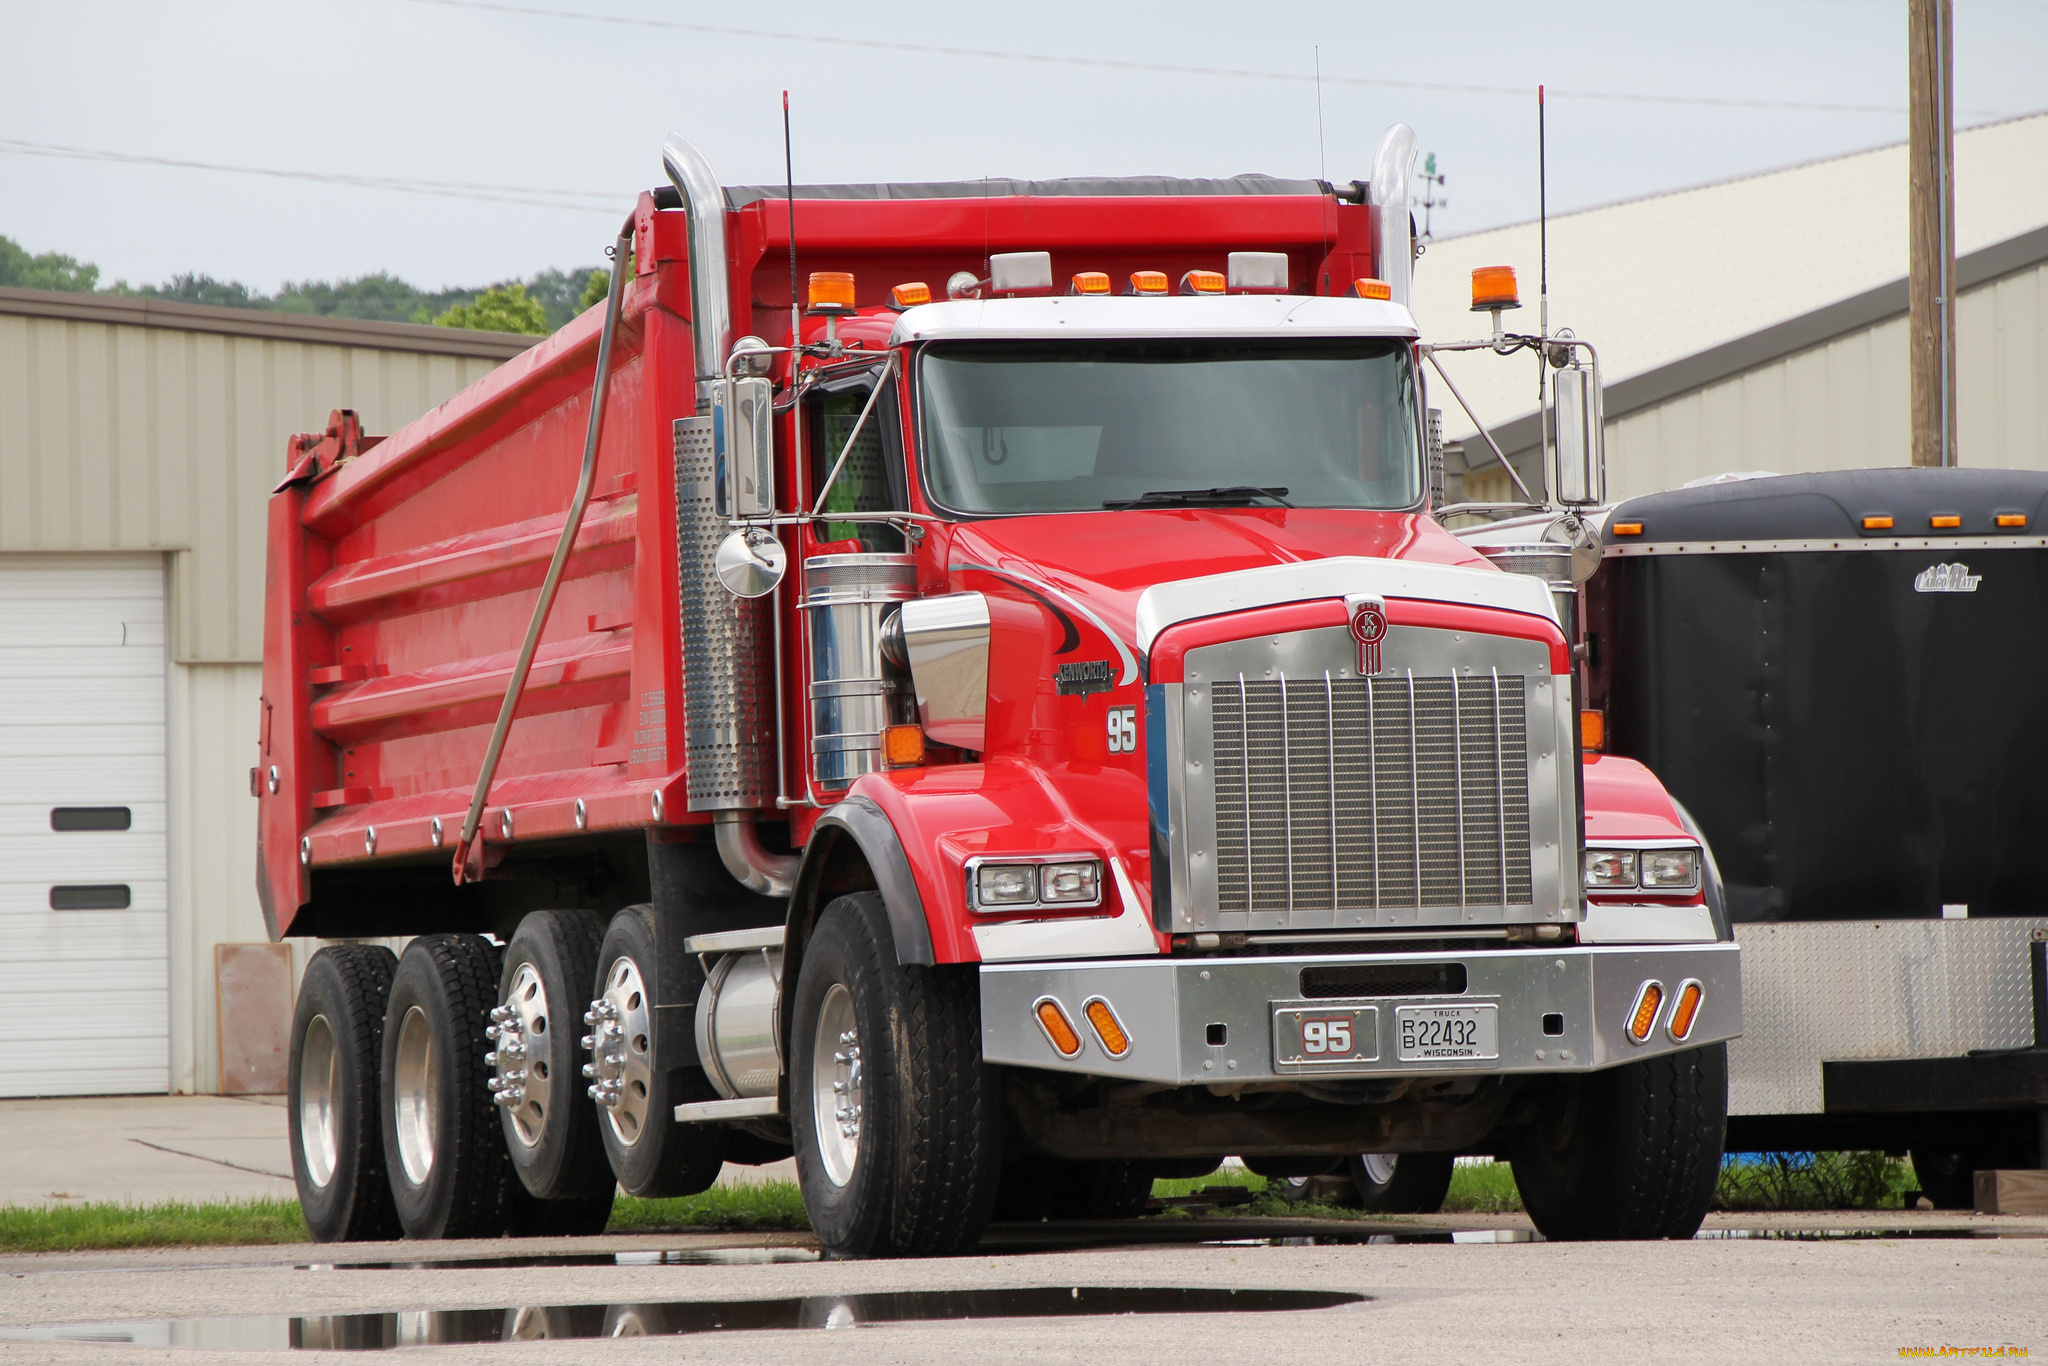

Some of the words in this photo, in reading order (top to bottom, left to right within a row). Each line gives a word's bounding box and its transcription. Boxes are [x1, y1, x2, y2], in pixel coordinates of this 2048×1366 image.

[1058, 660, 1109, 682] KENWORTH
[1107, 706, 1136, 754] 95
[1302, 1018, 1353, 1055] 95
[1418, 1020, 1477, 1046] 22432
[1423, 1048, 1473, 1057] WISCONSIN
